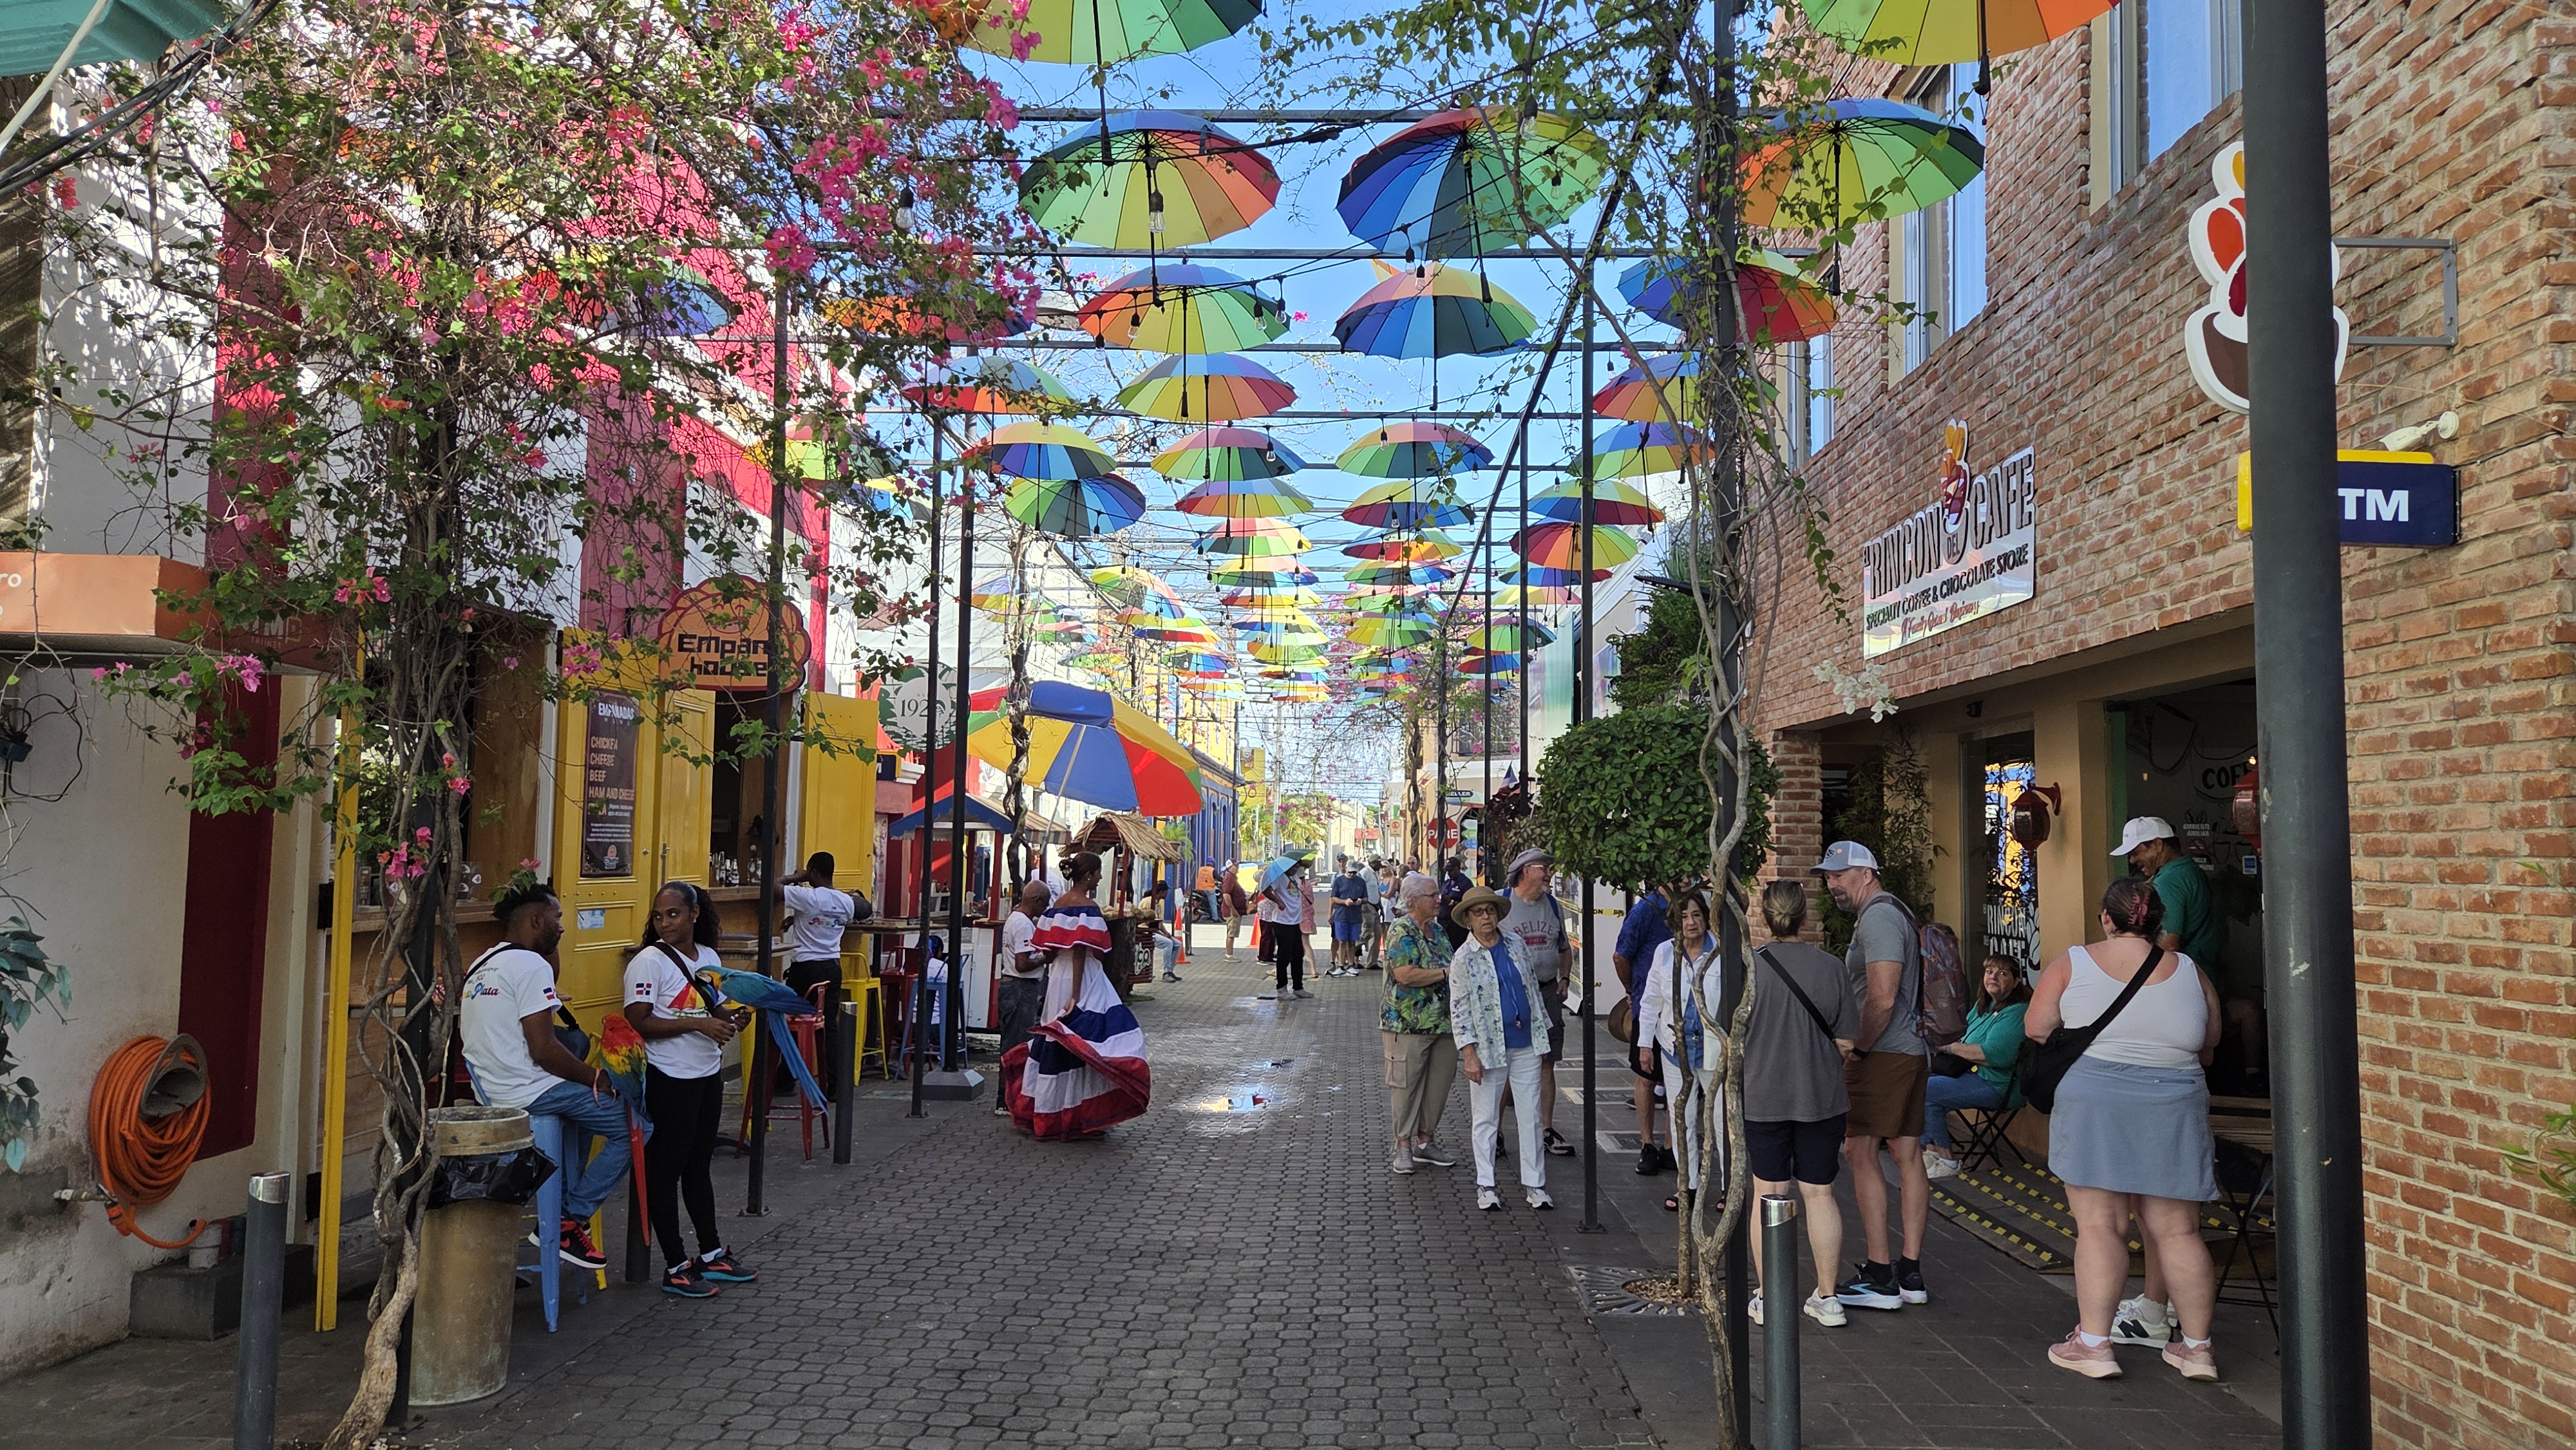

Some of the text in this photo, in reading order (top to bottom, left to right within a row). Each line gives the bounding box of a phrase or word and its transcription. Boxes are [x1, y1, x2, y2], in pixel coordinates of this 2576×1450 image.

[2338, 487, 2409, 522] TM
[1870, 506, 1942, 599] RINCON
[1947, 533, 1960, 560] DEL
[1970, 453, 2032, 549] CAFE
[1866, 543, 2029, 631] SPECIALTY COFFEE & CHOCOLATE STORE
[678, 634, 770, 660] Empan
[901, 698, 929, 717] 192
[590, 752, 616, 767] CHEESE
[589, 769, 606, 782] BEEF
[589, 786, 605, 798] HAM
[606, 787, 618, 800] AND
[1428, 829, 1458, 839] PE
[1513, 920, 1554, 936] BELIZE
[471, 983, 500, 1000] Plata
